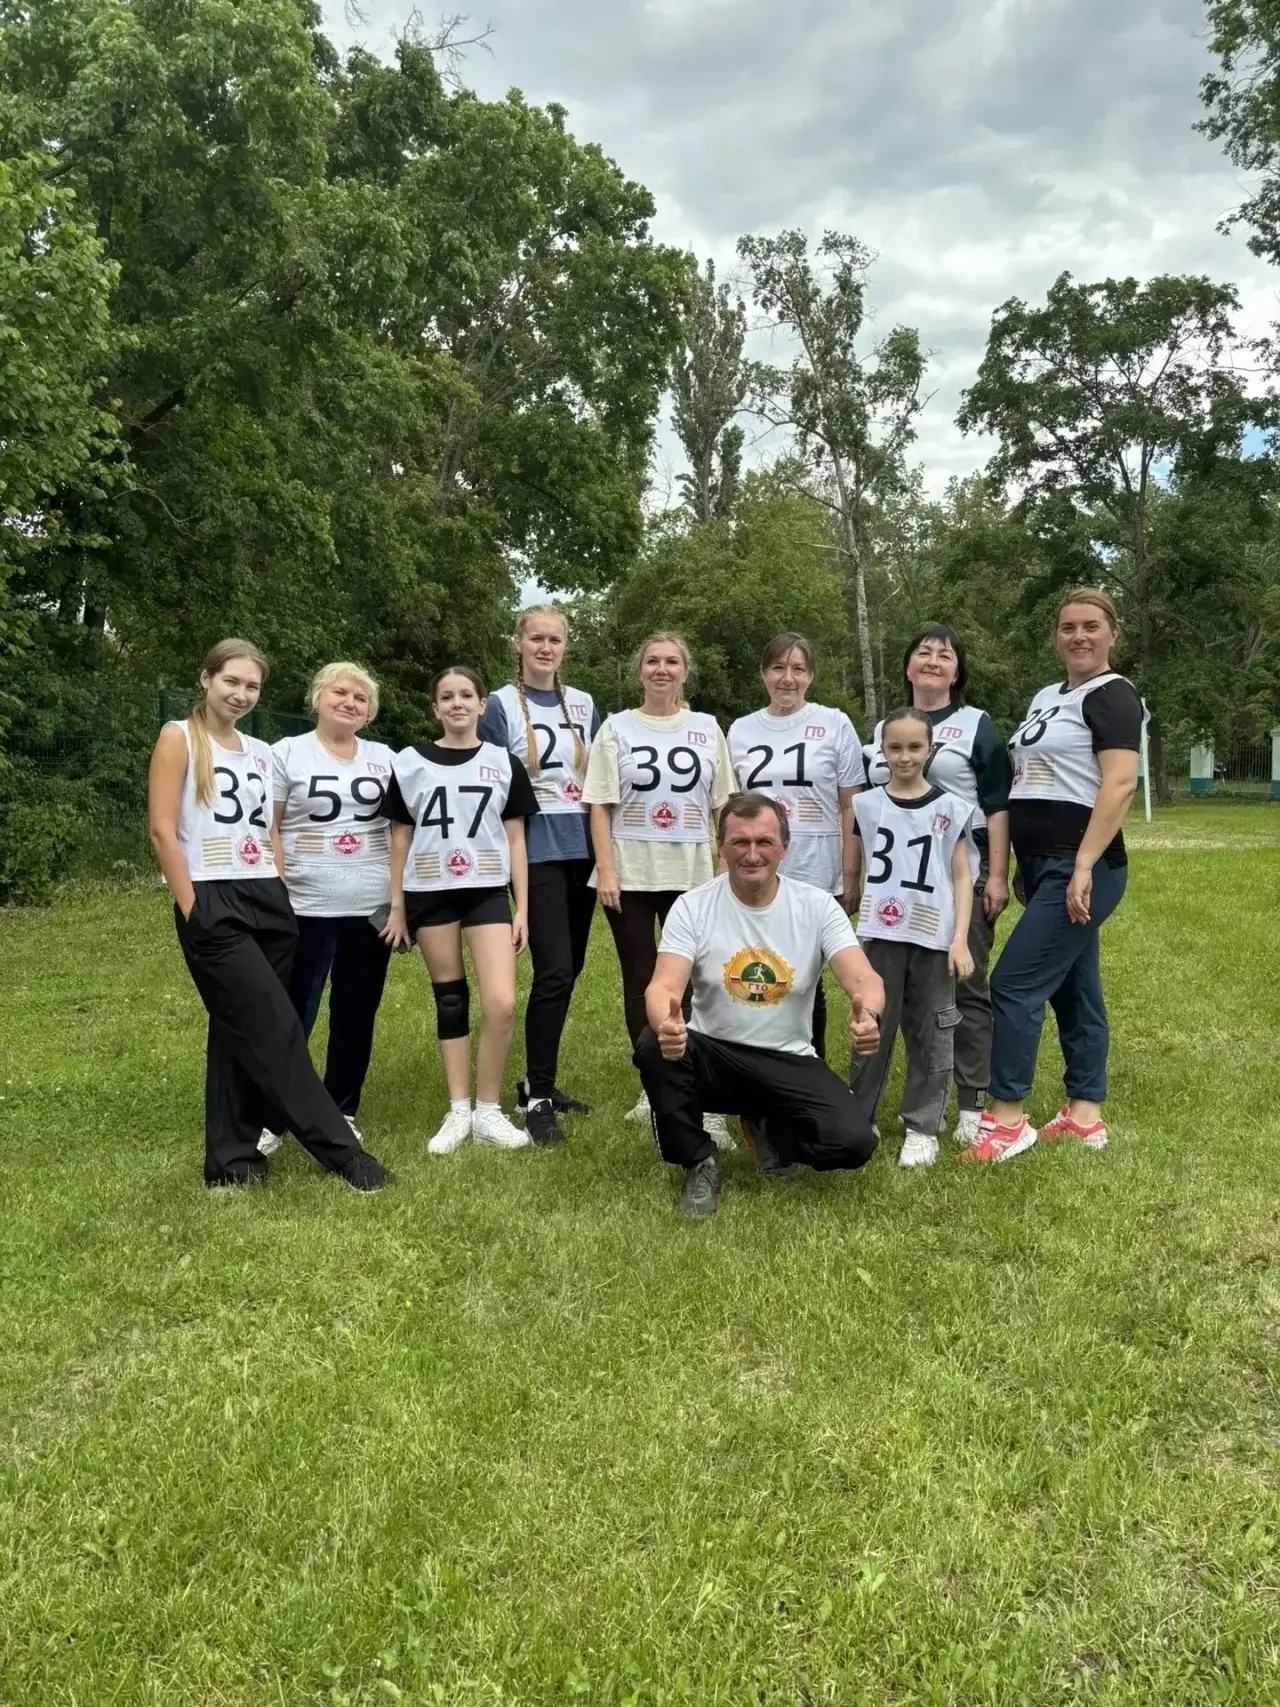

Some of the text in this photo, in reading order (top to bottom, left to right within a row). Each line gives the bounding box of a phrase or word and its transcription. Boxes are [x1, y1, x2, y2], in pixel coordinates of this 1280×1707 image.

[688, 731, 707, 744] ГТО
[805, 725, 826, 738] ГТО
[631, 746, 701, 793] 39
[746, 742, 813, 790] 21
[213, 766, 268, 828] 32
[308, 775, 386, 822] 59
[421, 785, 493, 839] 47
[867, 827, 935, 894] 31
[748, 983, 768, 992] ГТО
